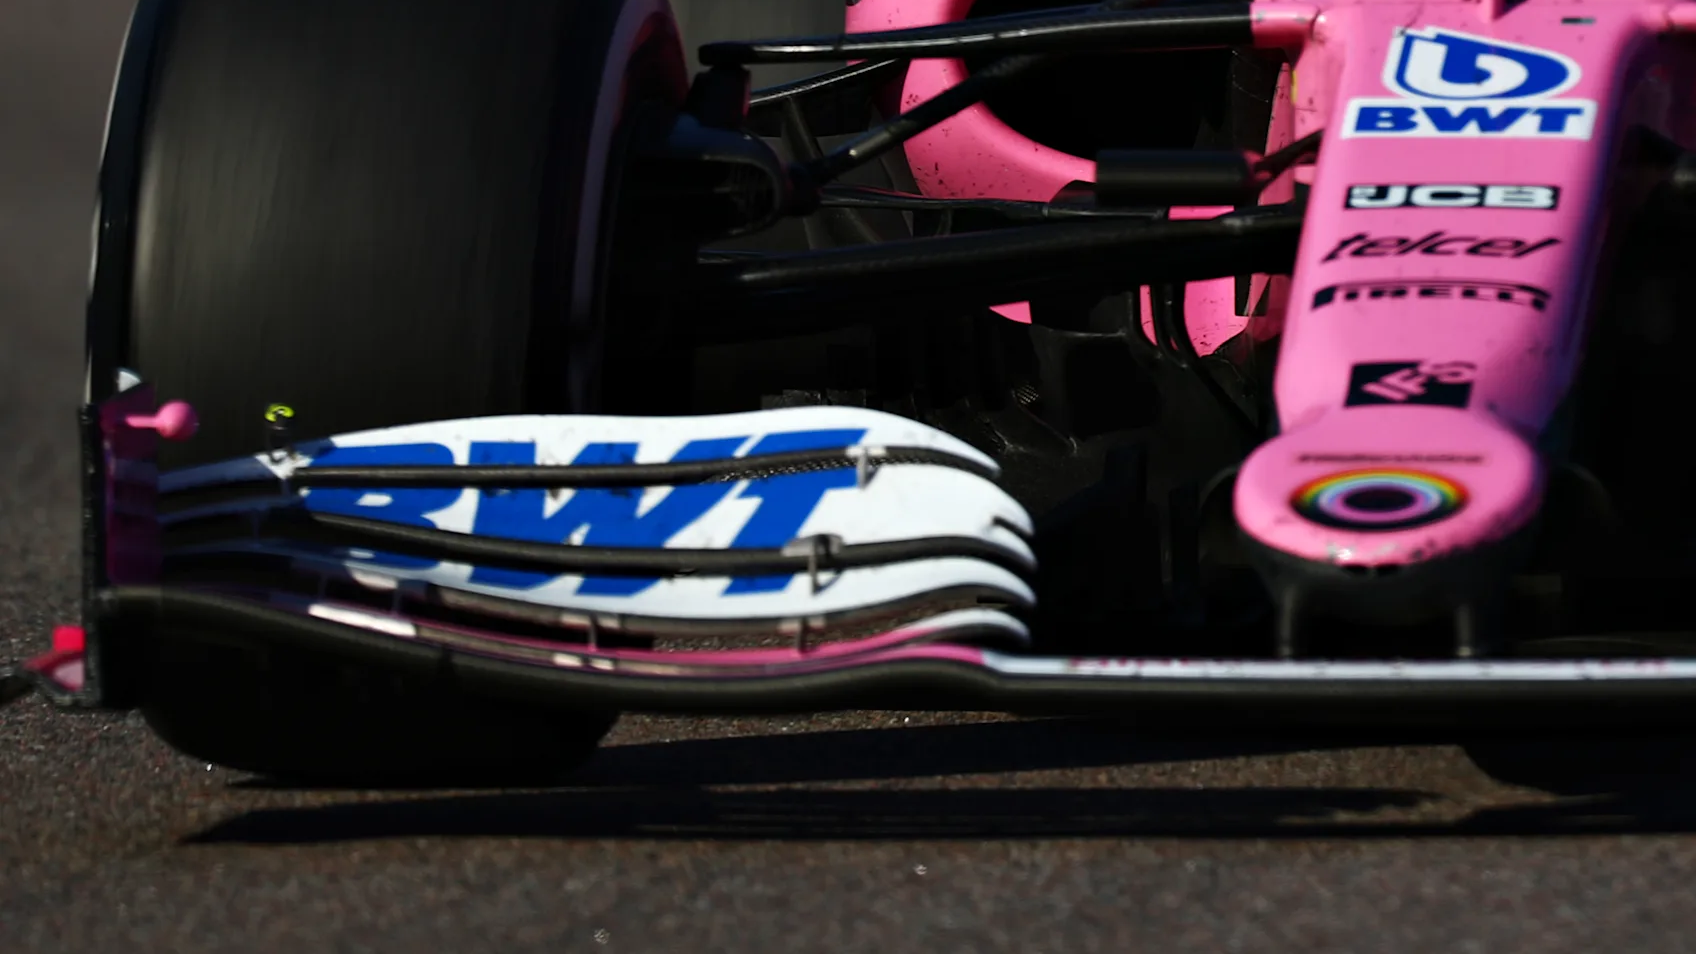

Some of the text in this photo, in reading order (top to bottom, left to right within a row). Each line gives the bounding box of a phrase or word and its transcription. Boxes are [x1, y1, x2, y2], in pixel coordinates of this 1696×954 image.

[1353, 106, 1584, 133] BWT
[1349, 184, 1556, 209] JCB
[1320, 231, 1561, 264] telcel
[1311, 278, 1551, 311] PIRELLI
[302, 428, 869, 598] BWT
